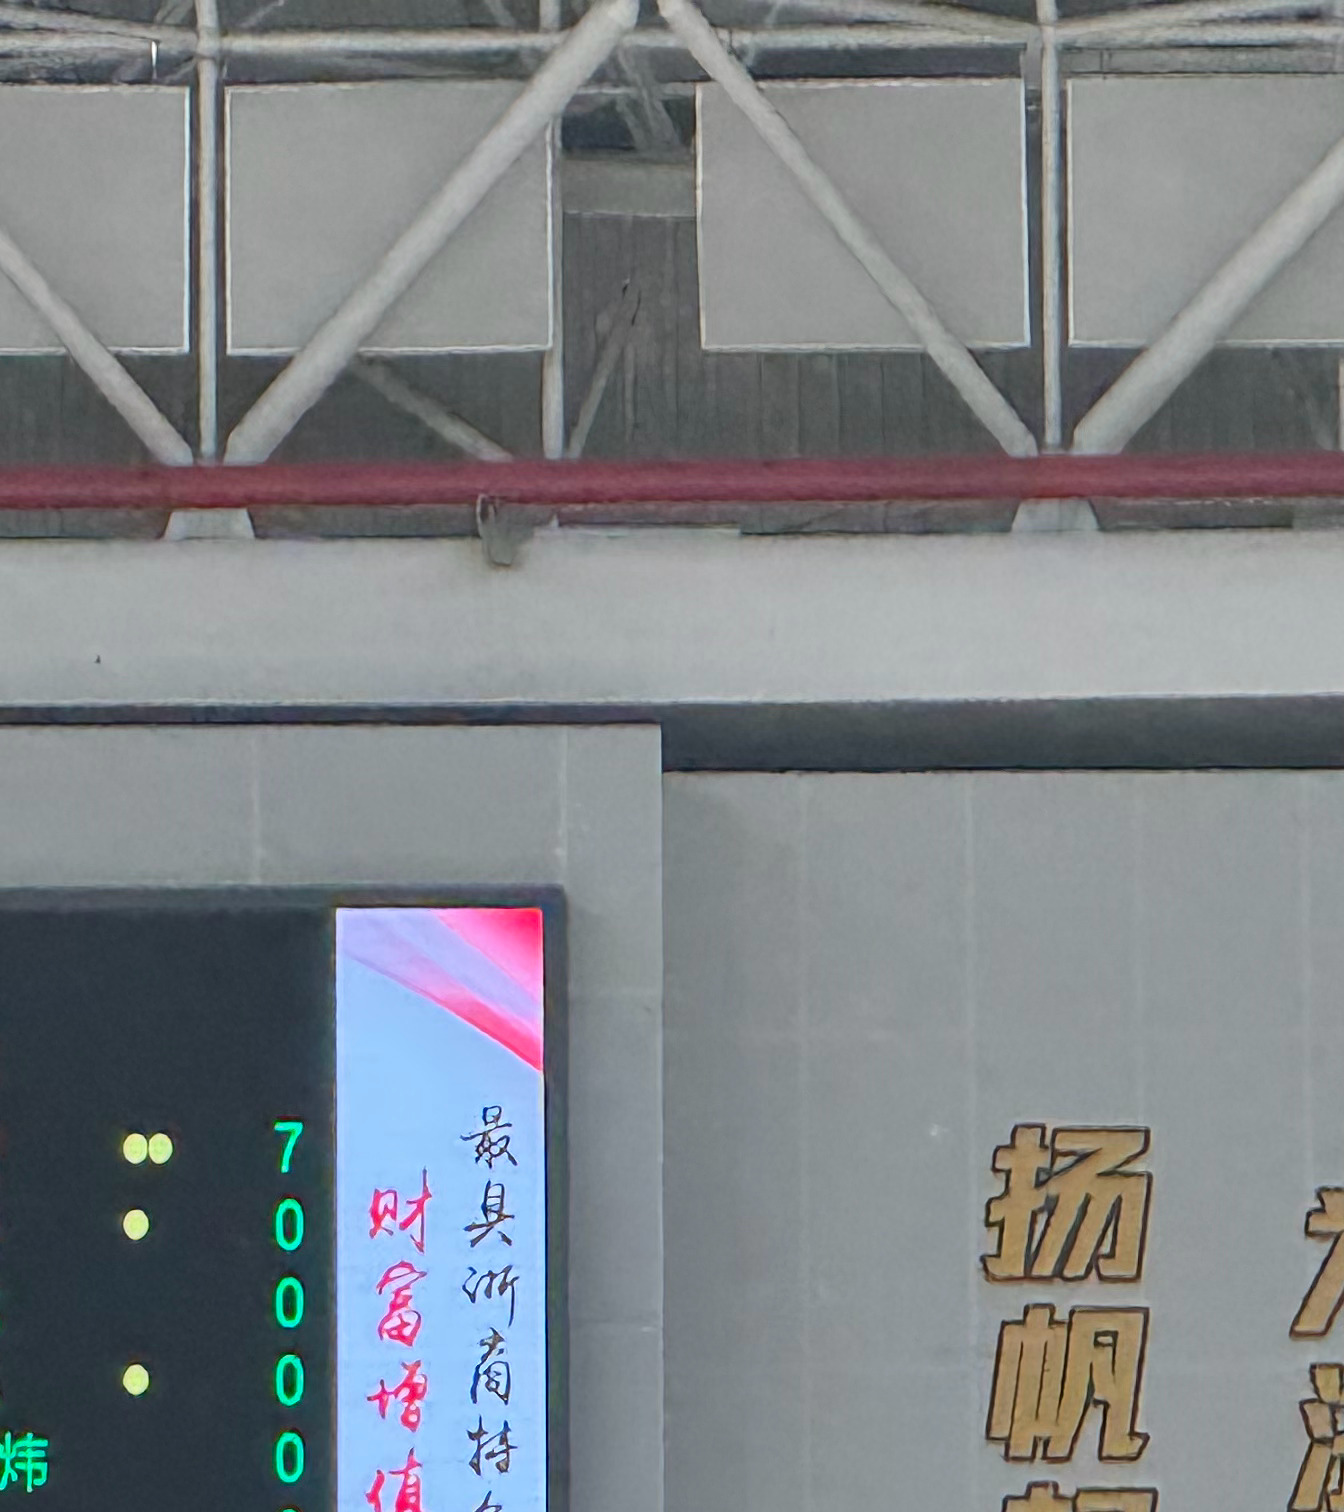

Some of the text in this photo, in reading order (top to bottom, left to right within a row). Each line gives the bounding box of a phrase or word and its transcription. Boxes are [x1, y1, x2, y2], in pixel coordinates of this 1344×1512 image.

[274, 1122, 304, 1173] 7
[275, 1199, 304, 1250] 0
[276, 1277, 304, 1328] 0
[276, 1355, 304, 1406] 0
[275, 1432, 304, 1483] 0
